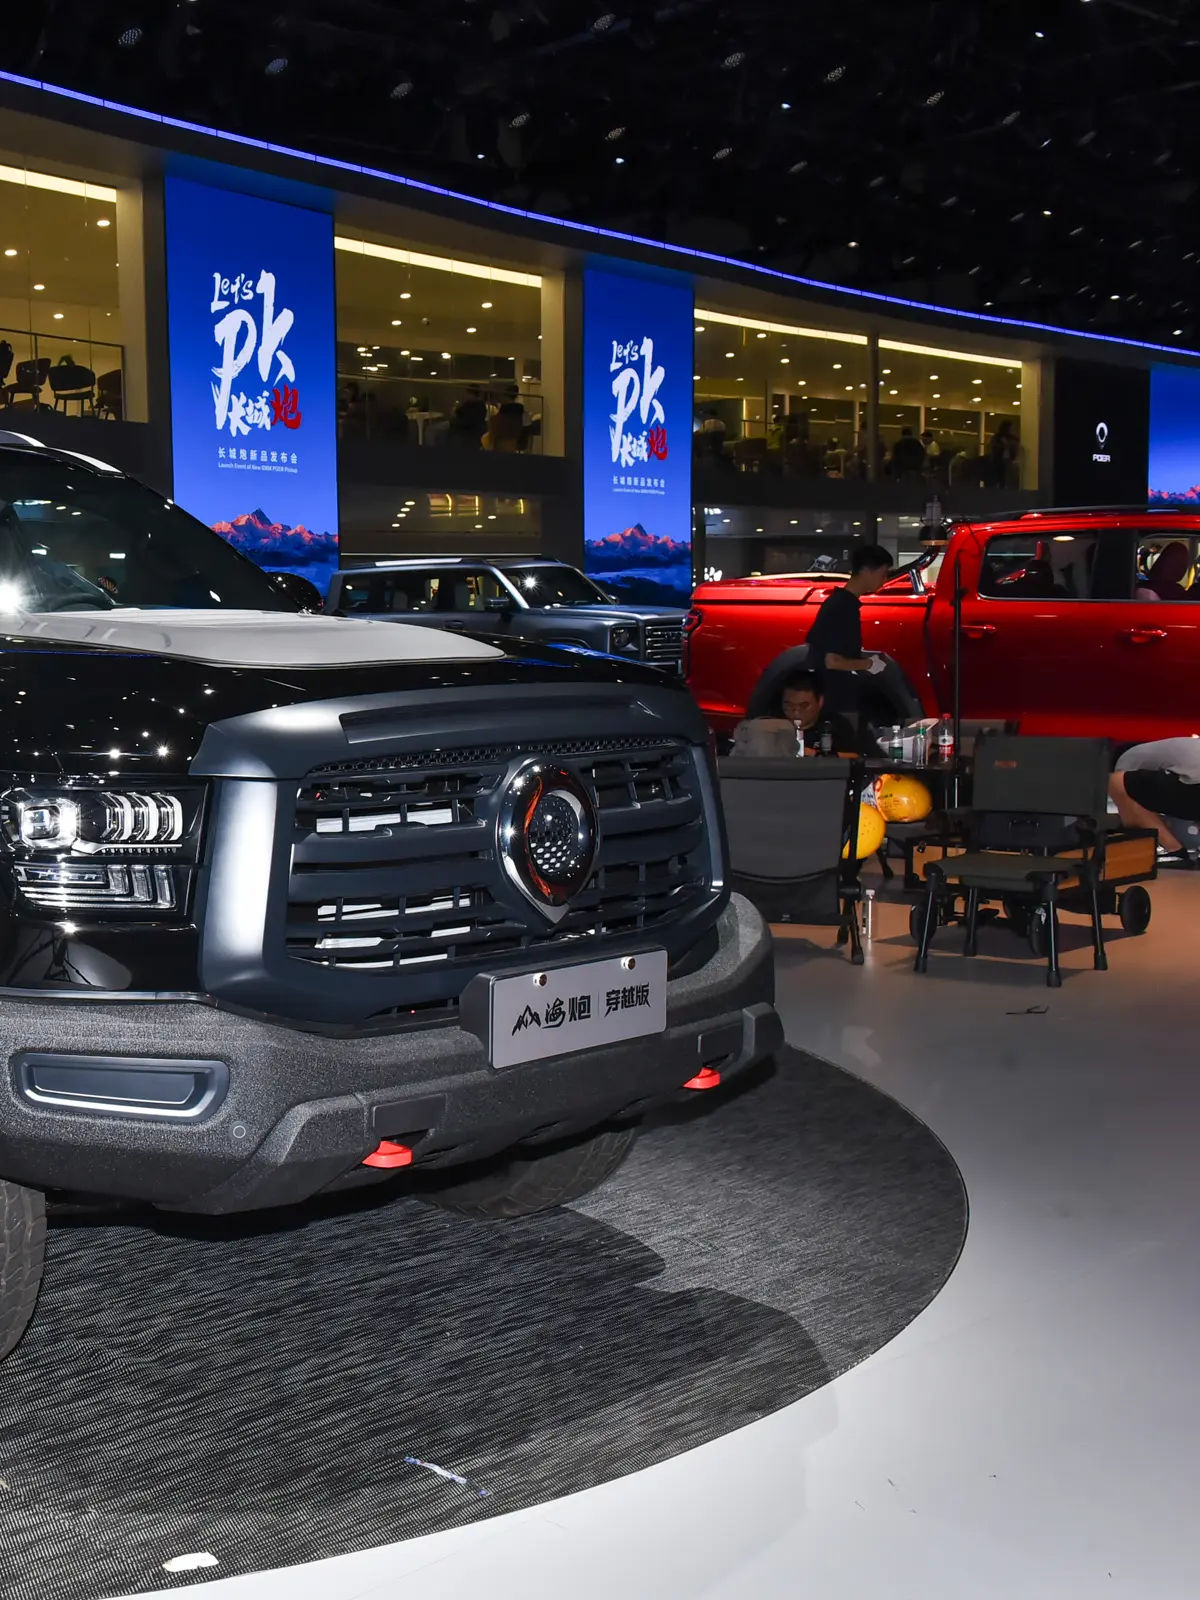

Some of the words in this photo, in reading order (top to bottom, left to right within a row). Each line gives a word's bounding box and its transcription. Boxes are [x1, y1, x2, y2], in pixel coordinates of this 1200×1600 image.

[210, 272, 254, 313] Let's
[609, 340, 639, 373] Let's
[227, 384, 303, 438] 长城炮
[218, 446, 298, 464] 长城炮新品发布会
[1092, 453, 1111, 463] POER
[604, 981, 651, 1019] 穿越版
